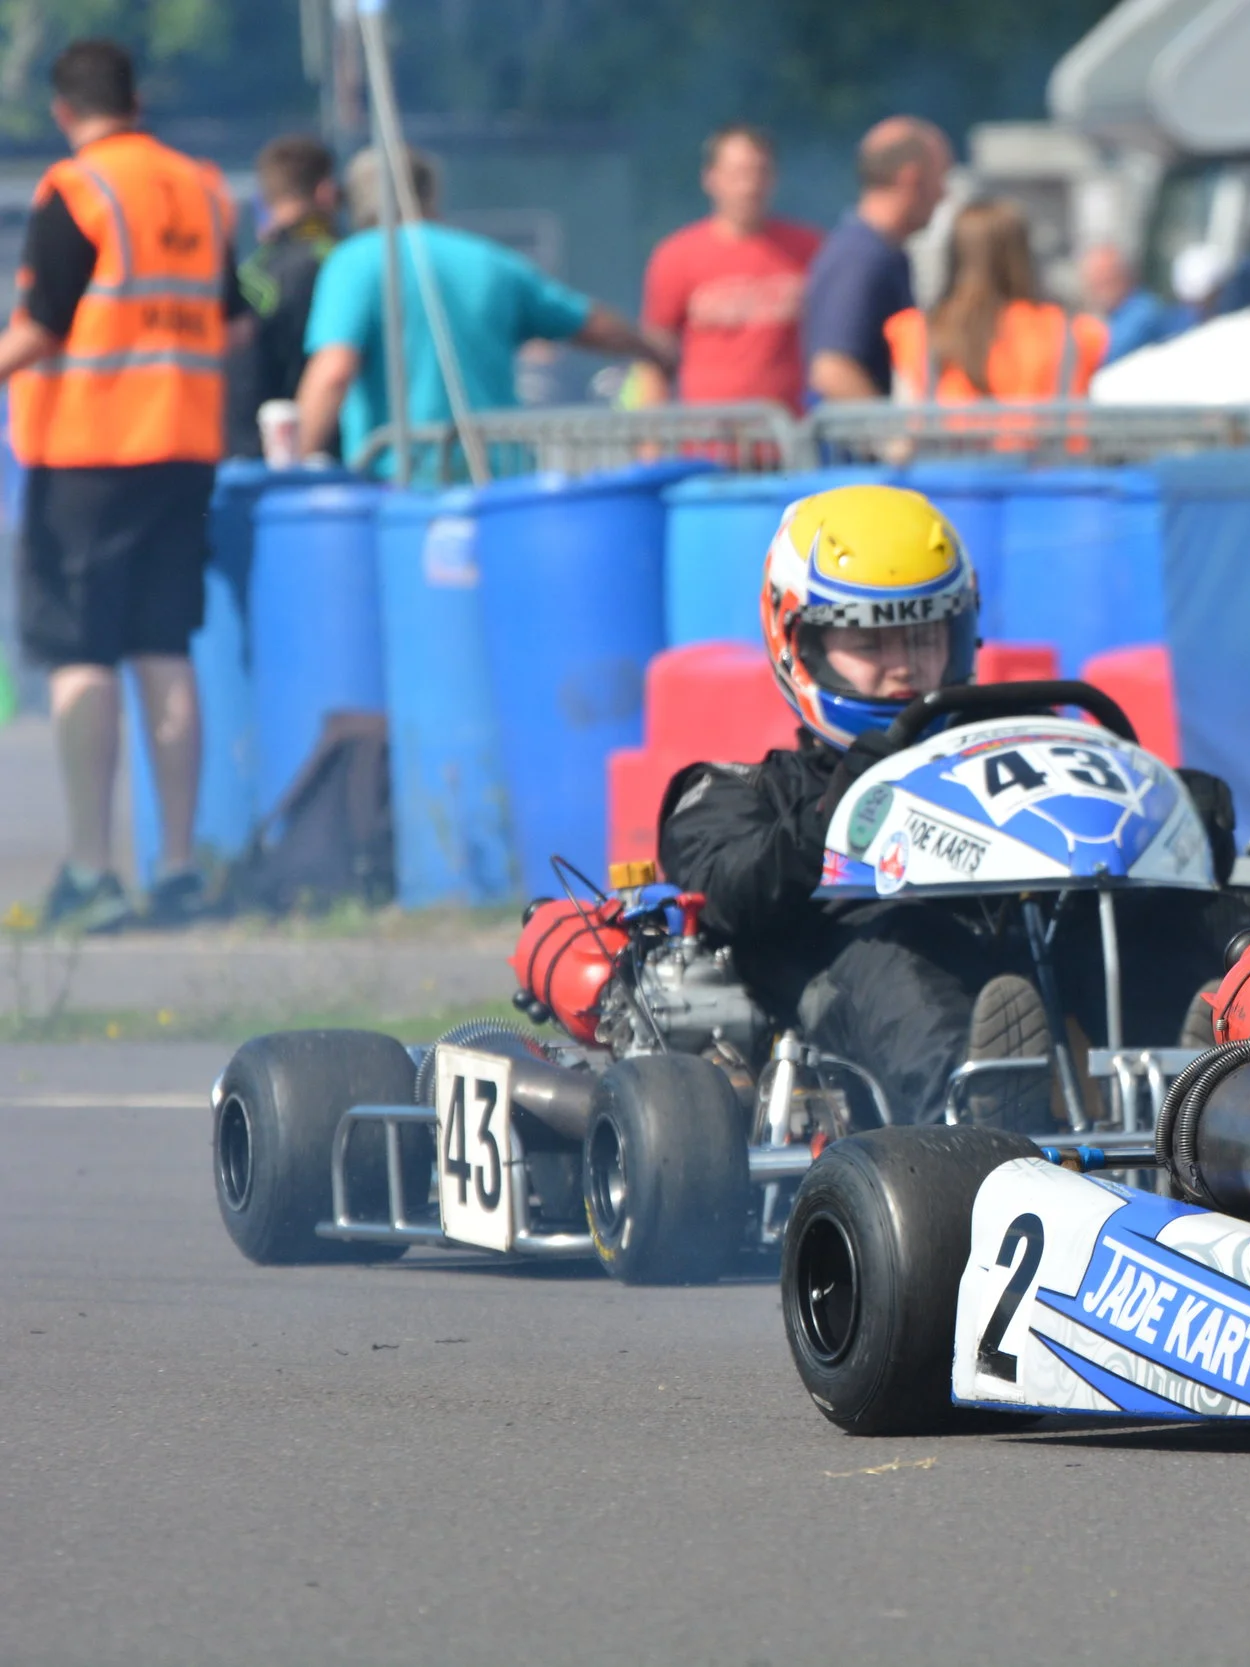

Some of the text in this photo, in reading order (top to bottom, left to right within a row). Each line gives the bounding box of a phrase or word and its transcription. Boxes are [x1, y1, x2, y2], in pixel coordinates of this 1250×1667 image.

[872, 598, 933, 623] NKF
[984, 747, 1128, 798] 43
[931, 830, 987, 873] KARTS
[444, 1074, 502, 1213] 43
[976, 1212, 1045, 1383] 2
[1083, 1238, 1178, 1345] JADE
